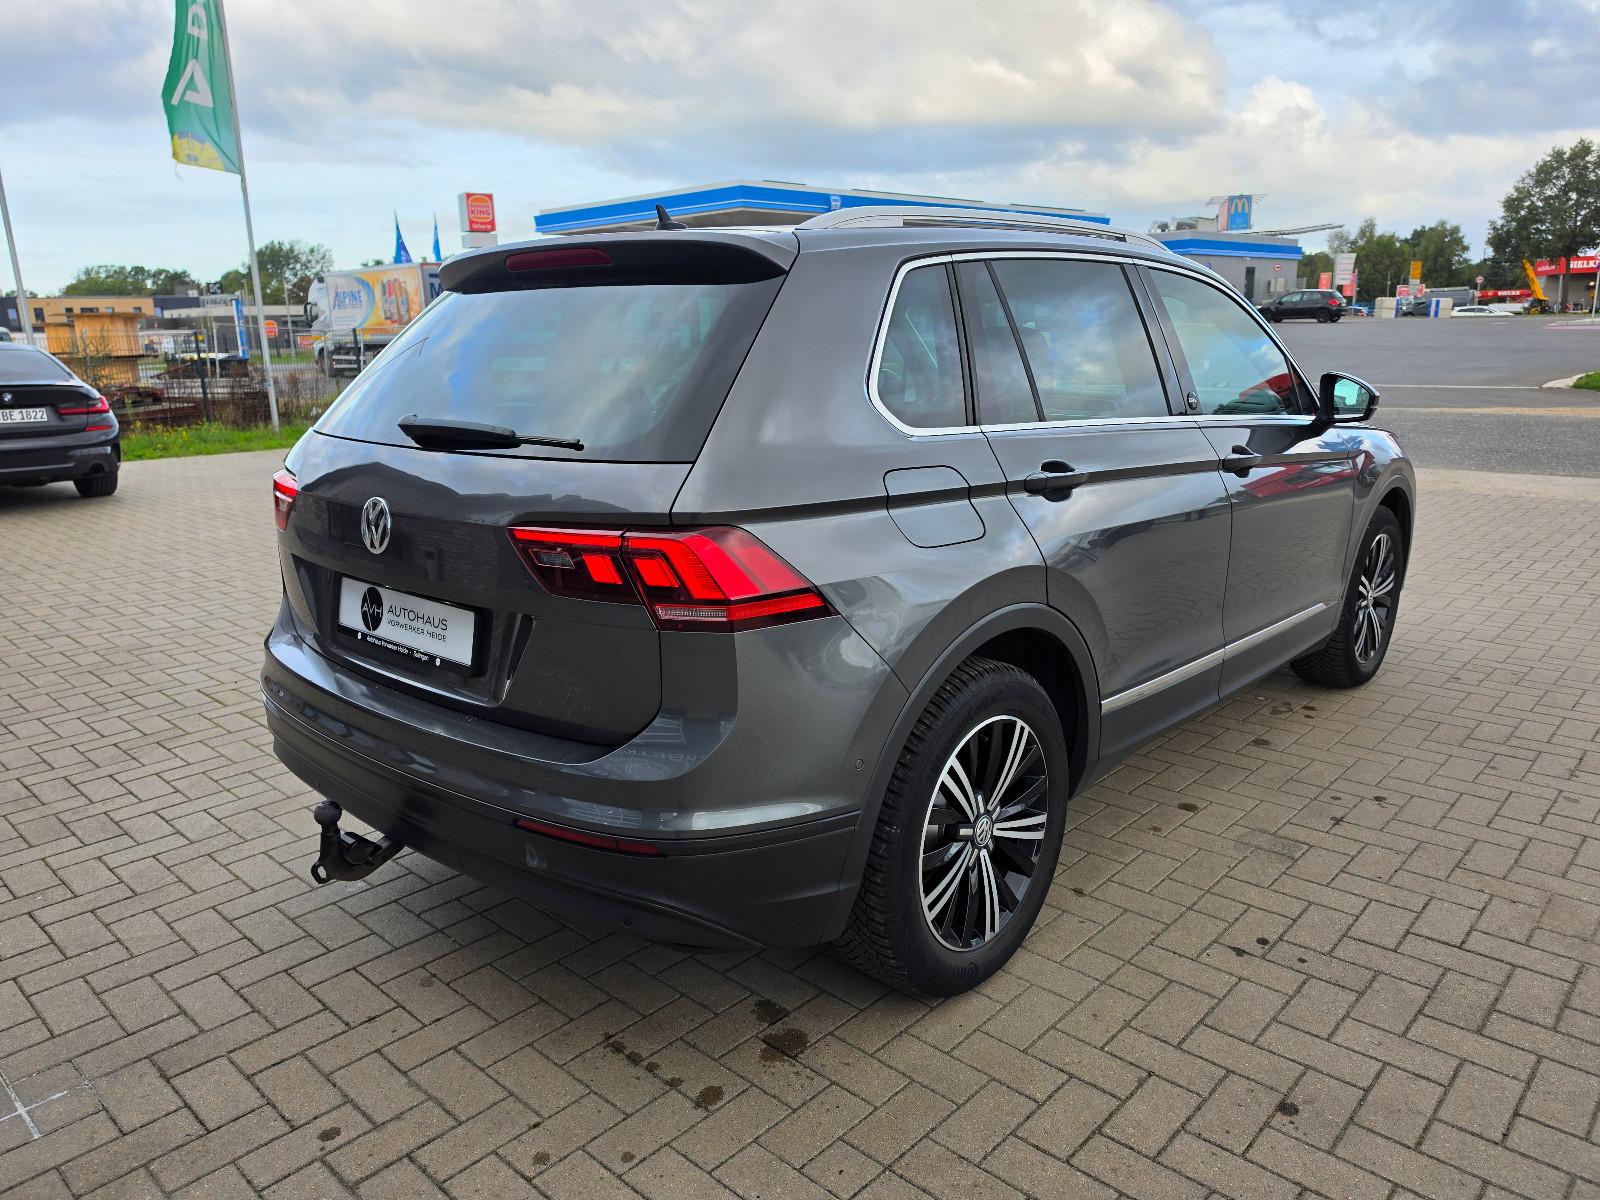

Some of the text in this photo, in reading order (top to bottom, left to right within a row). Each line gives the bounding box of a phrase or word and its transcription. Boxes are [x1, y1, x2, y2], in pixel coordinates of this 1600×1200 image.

[19, 409, 46, 420] 1822
[387, 605, 448, 631] AUTOHAUS
[387, 618, 447, 642] VORWERKER HEIDE
